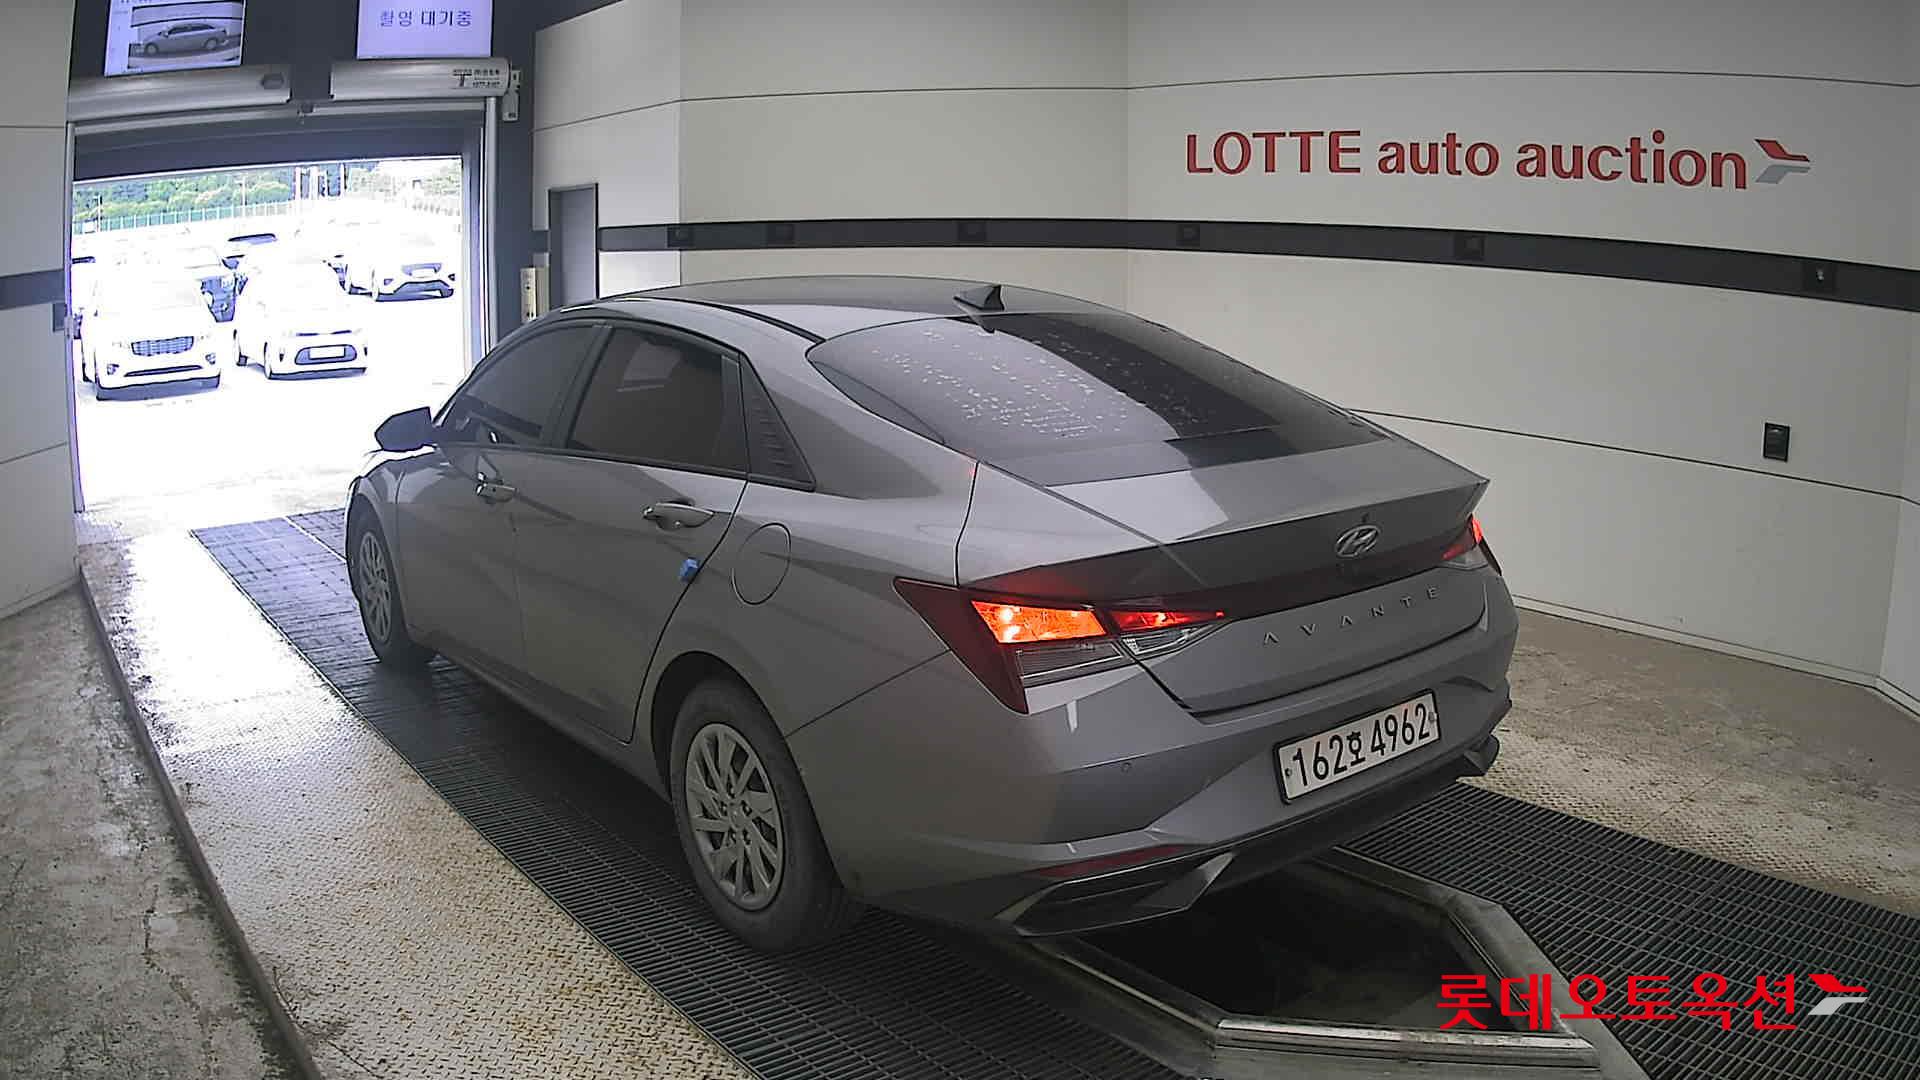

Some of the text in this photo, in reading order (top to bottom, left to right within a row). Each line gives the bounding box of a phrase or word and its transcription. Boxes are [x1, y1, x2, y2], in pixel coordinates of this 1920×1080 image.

[420, 10, 473, 28] 대기중
[1186, 130, 1747, 189] LOTTE auto auction
[1262, 586, 1440, 646] AVANTE
